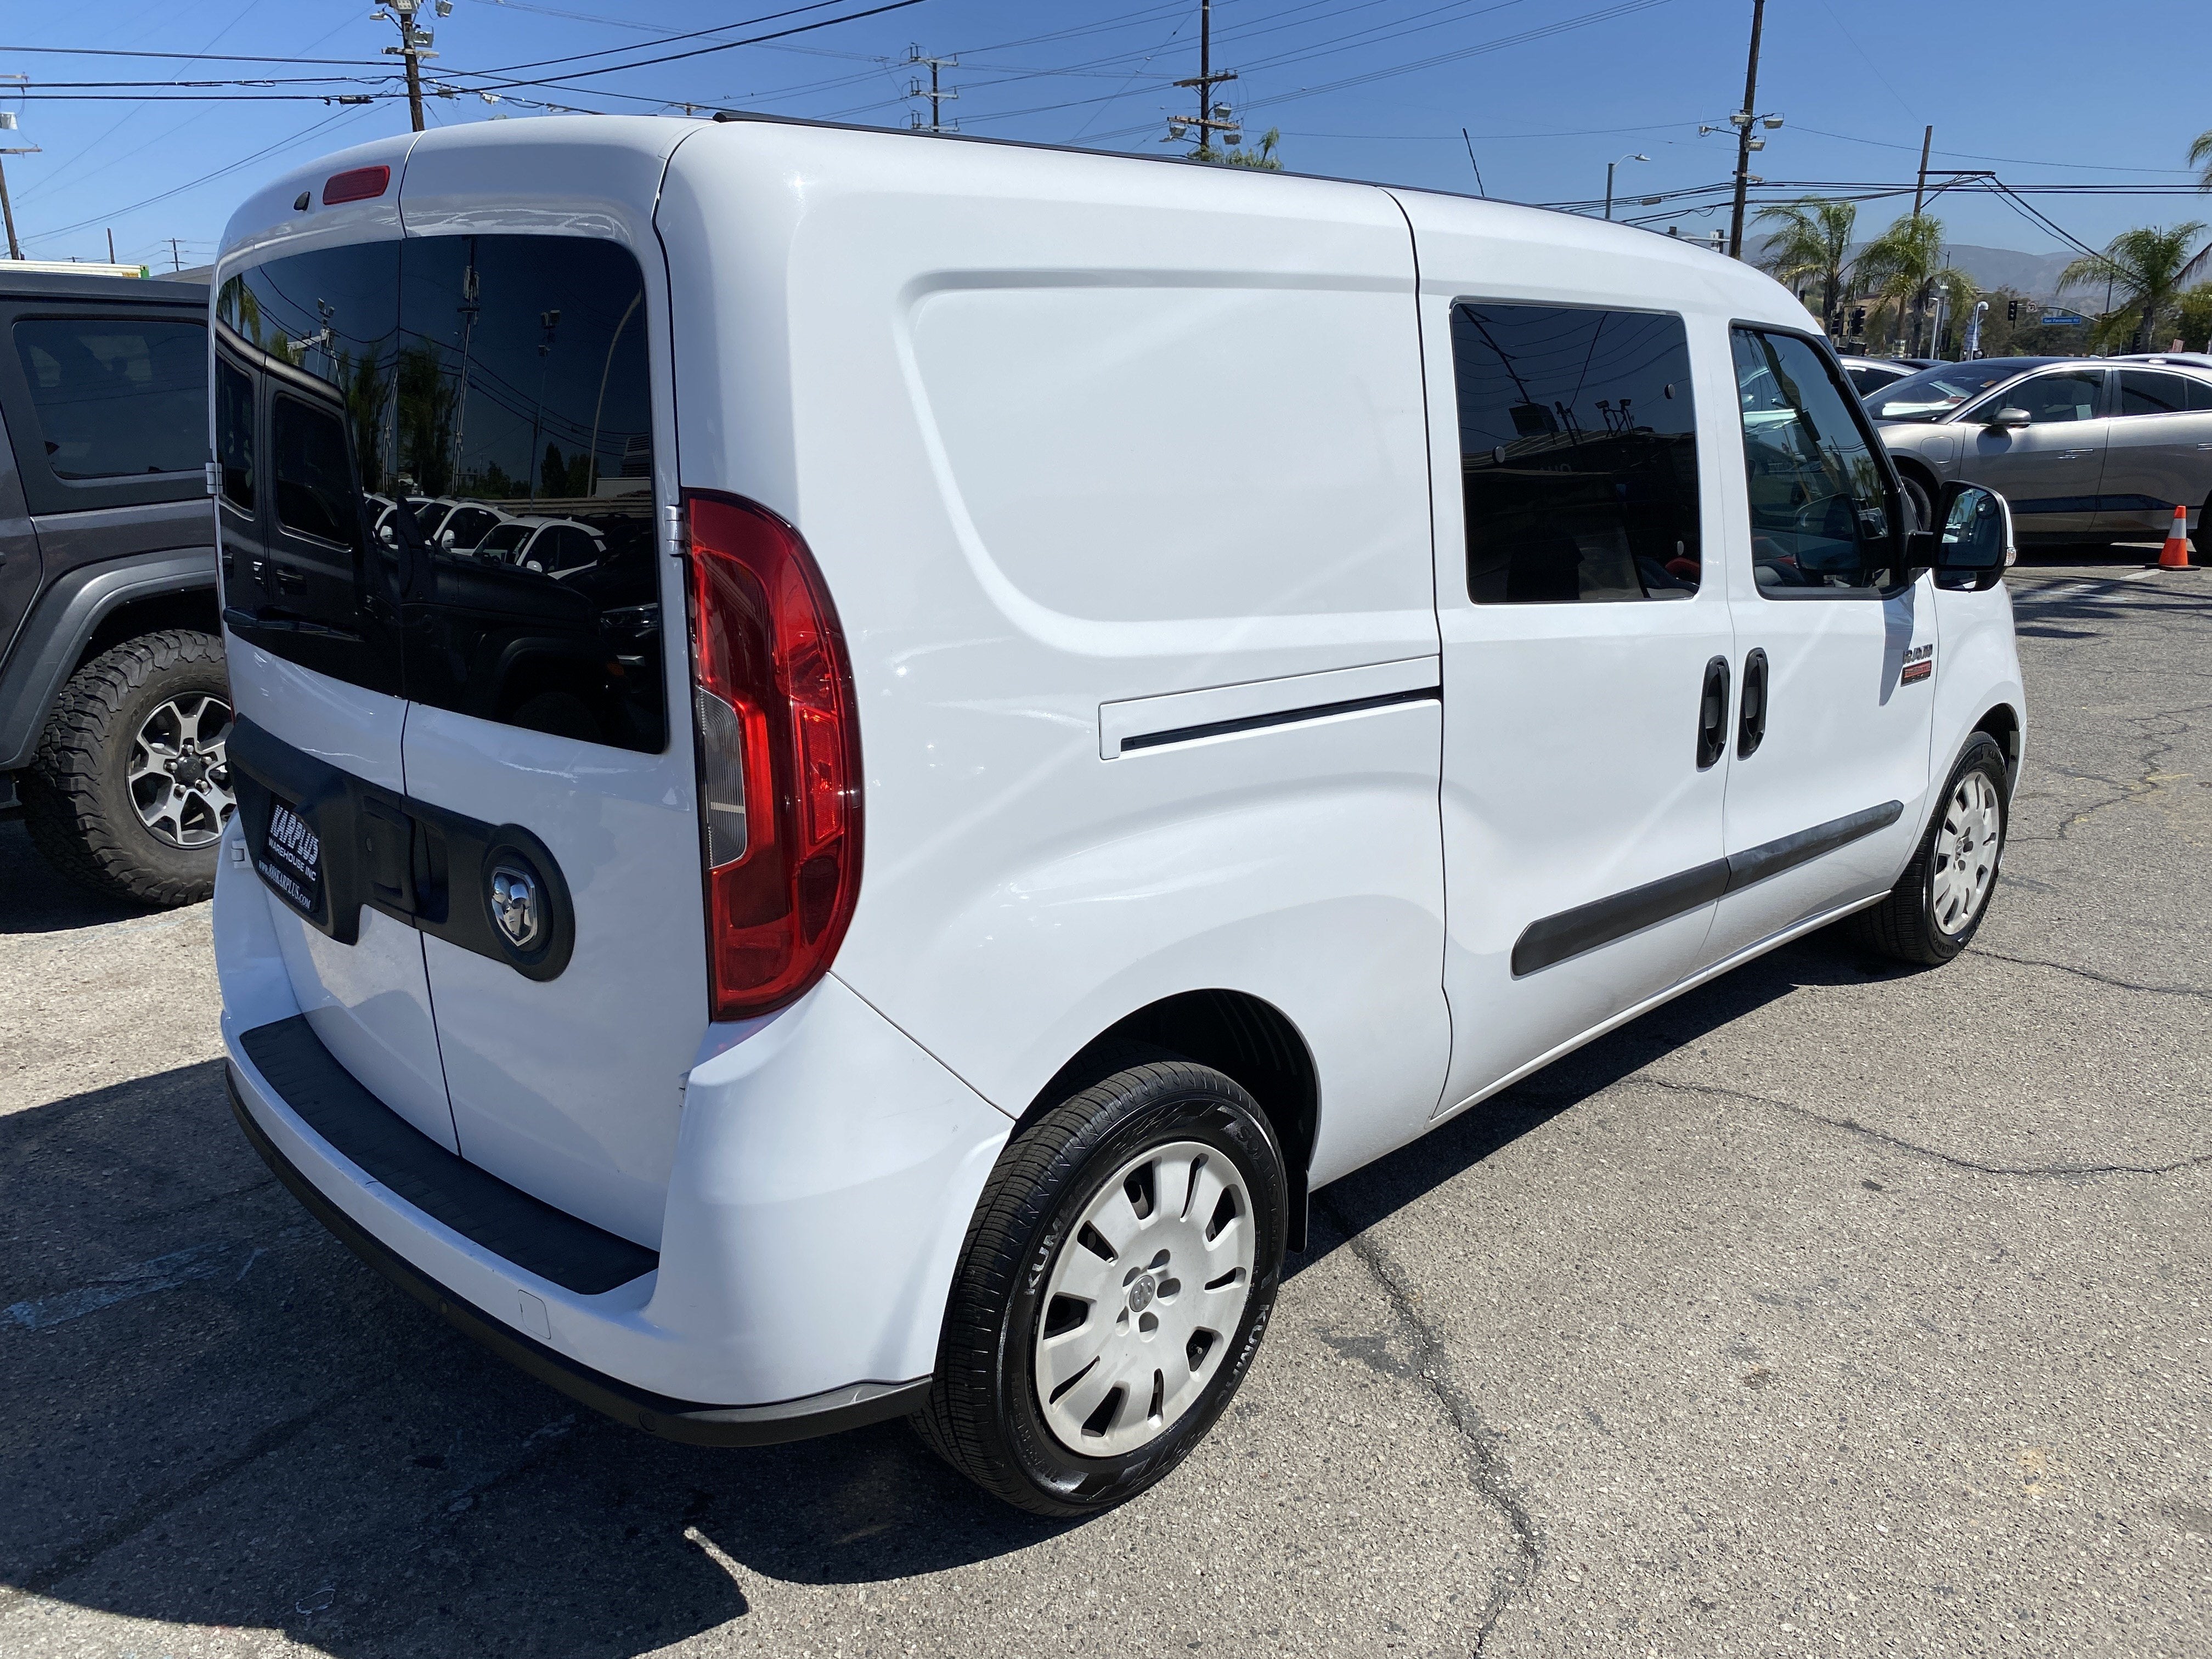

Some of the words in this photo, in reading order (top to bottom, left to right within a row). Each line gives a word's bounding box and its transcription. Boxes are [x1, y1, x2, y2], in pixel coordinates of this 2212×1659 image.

[1903, 644, 1933, 664] RAM
[268, 837, 304, 872] WAREHOUSE
[305, 864, 317, 881] INC
[270, 804, 319, 865] KARPLUS
[1023, 1174, 1093, 1296] KUMHO
[1215, 1304, 1270, 1412] KUMHO
